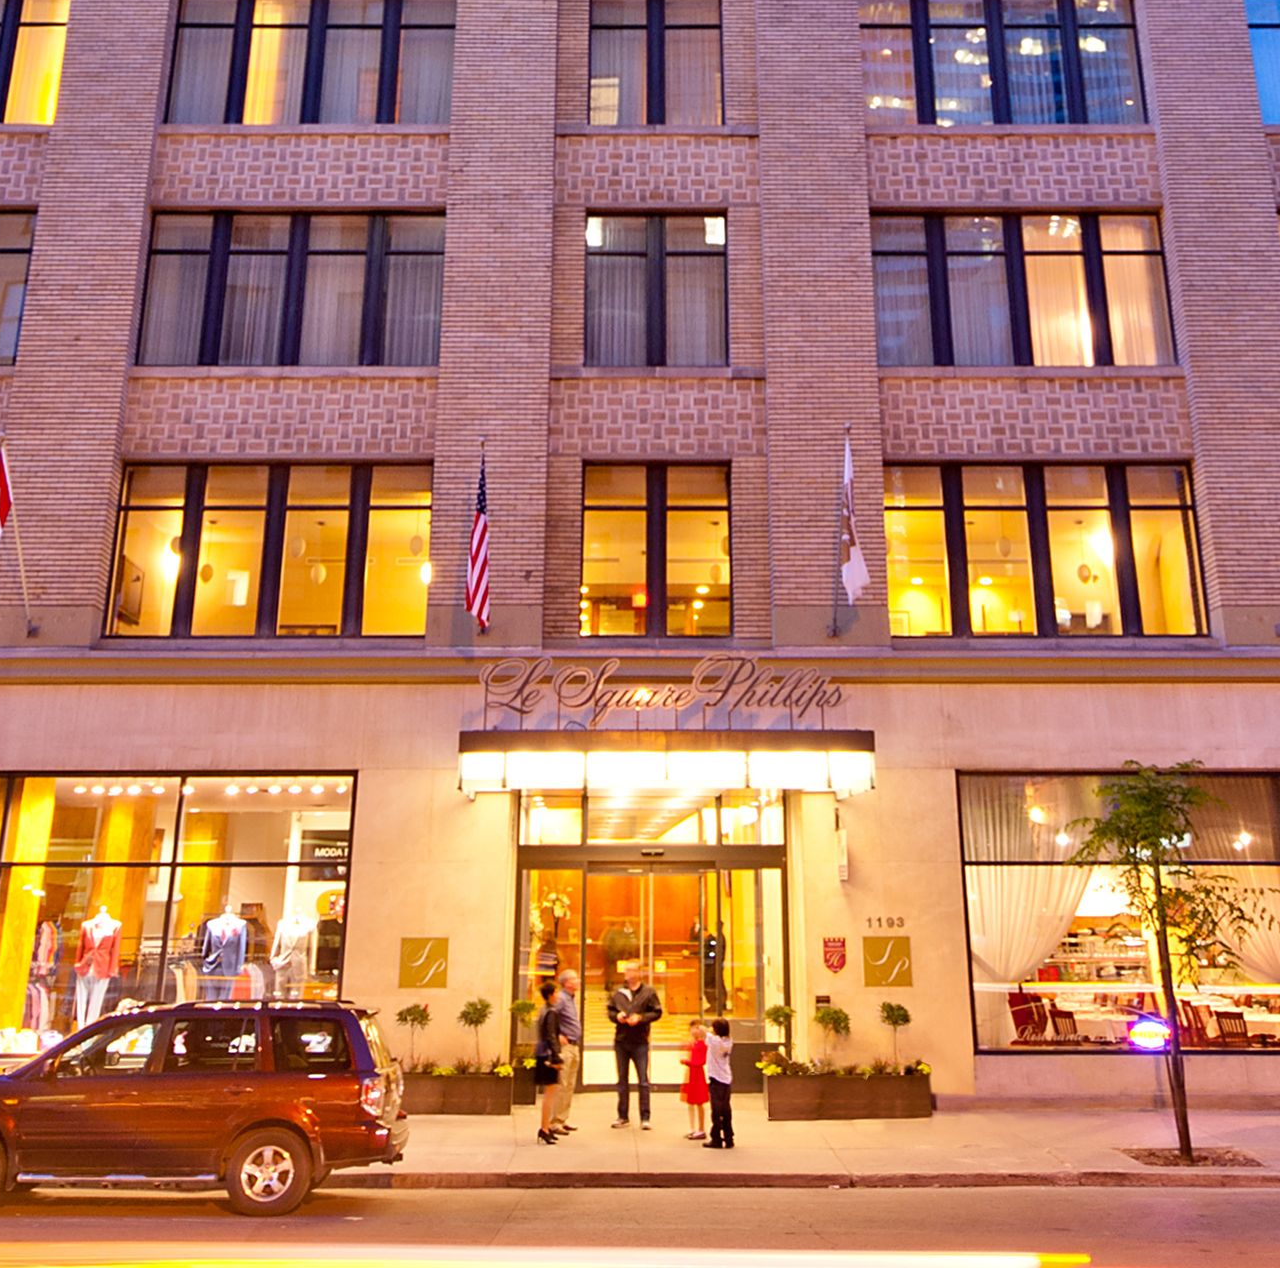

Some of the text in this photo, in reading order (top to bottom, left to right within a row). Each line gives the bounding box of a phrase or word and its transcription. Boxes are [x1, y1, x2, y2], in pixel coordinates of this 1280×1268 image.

[480, 653, 845, 728] Le Square Phillips
[866, 916, 905, 928] 1193
